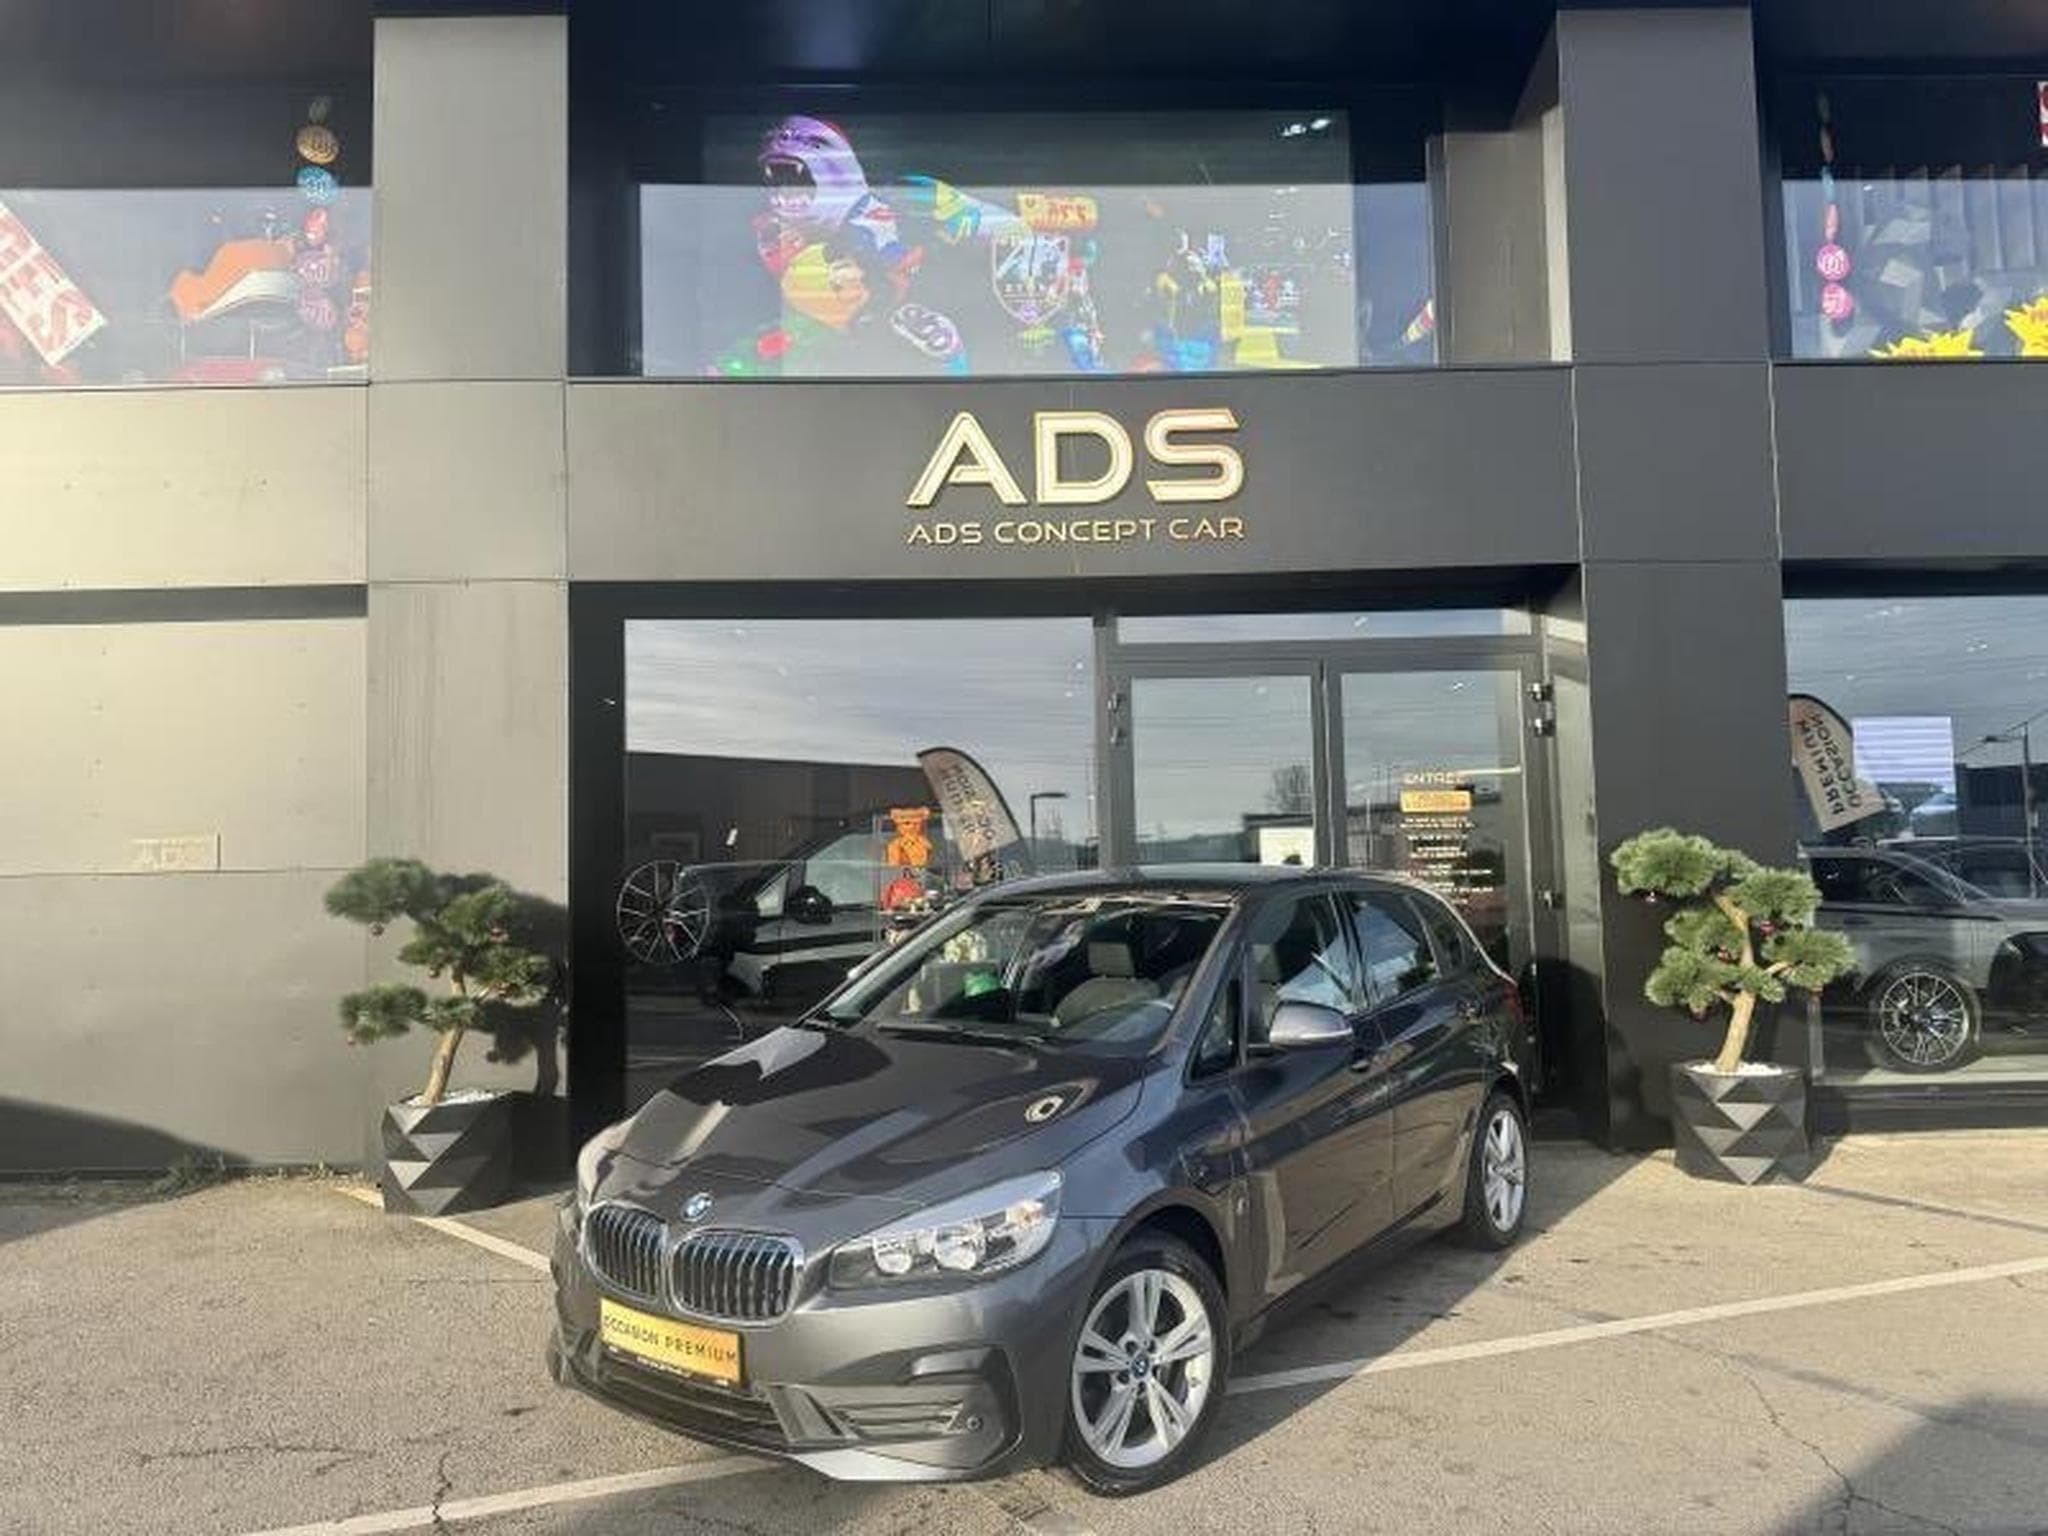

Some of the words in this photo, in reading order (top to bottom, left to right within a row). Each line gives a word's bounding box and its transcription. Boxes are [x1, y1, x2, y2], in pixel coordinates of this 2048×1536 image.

[905, 408, 1244, 506] ADS
[907, 521, 982, 545] ADS
[993, 518, 1156, 544] CONCEPT
[1168, 517, 1245, 541] CAR
[604, 1314, 660, 1347] OCCASION
[665, 1335, 737, 1362] PREMIUM
